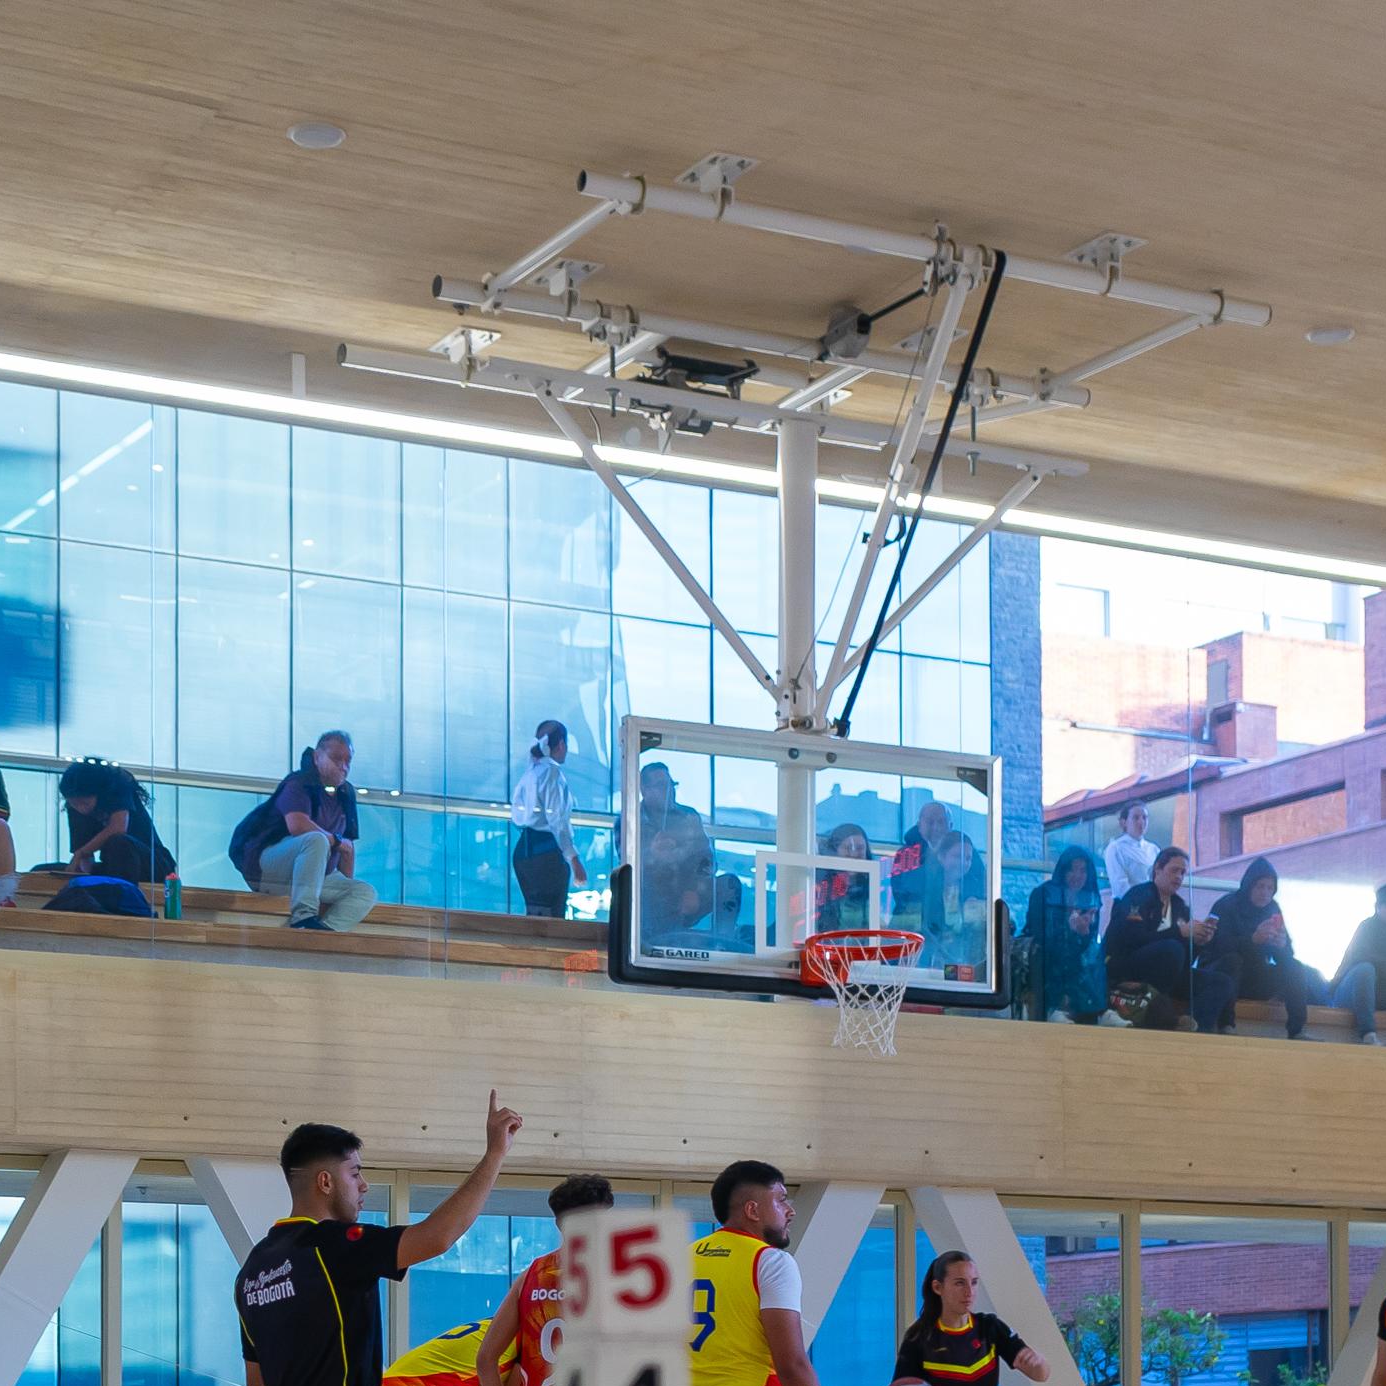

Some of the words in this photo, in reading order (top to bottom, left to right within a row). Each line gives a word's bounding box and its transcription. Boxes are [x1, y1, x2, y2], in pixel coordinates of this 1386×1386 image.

[666, 948, 710, 959] GARED
[611, 1225, 671, 1310] 5
[246, 1291, 258, 1306] DE
[257, 1277, 295, 1306] BOGOTÁ
